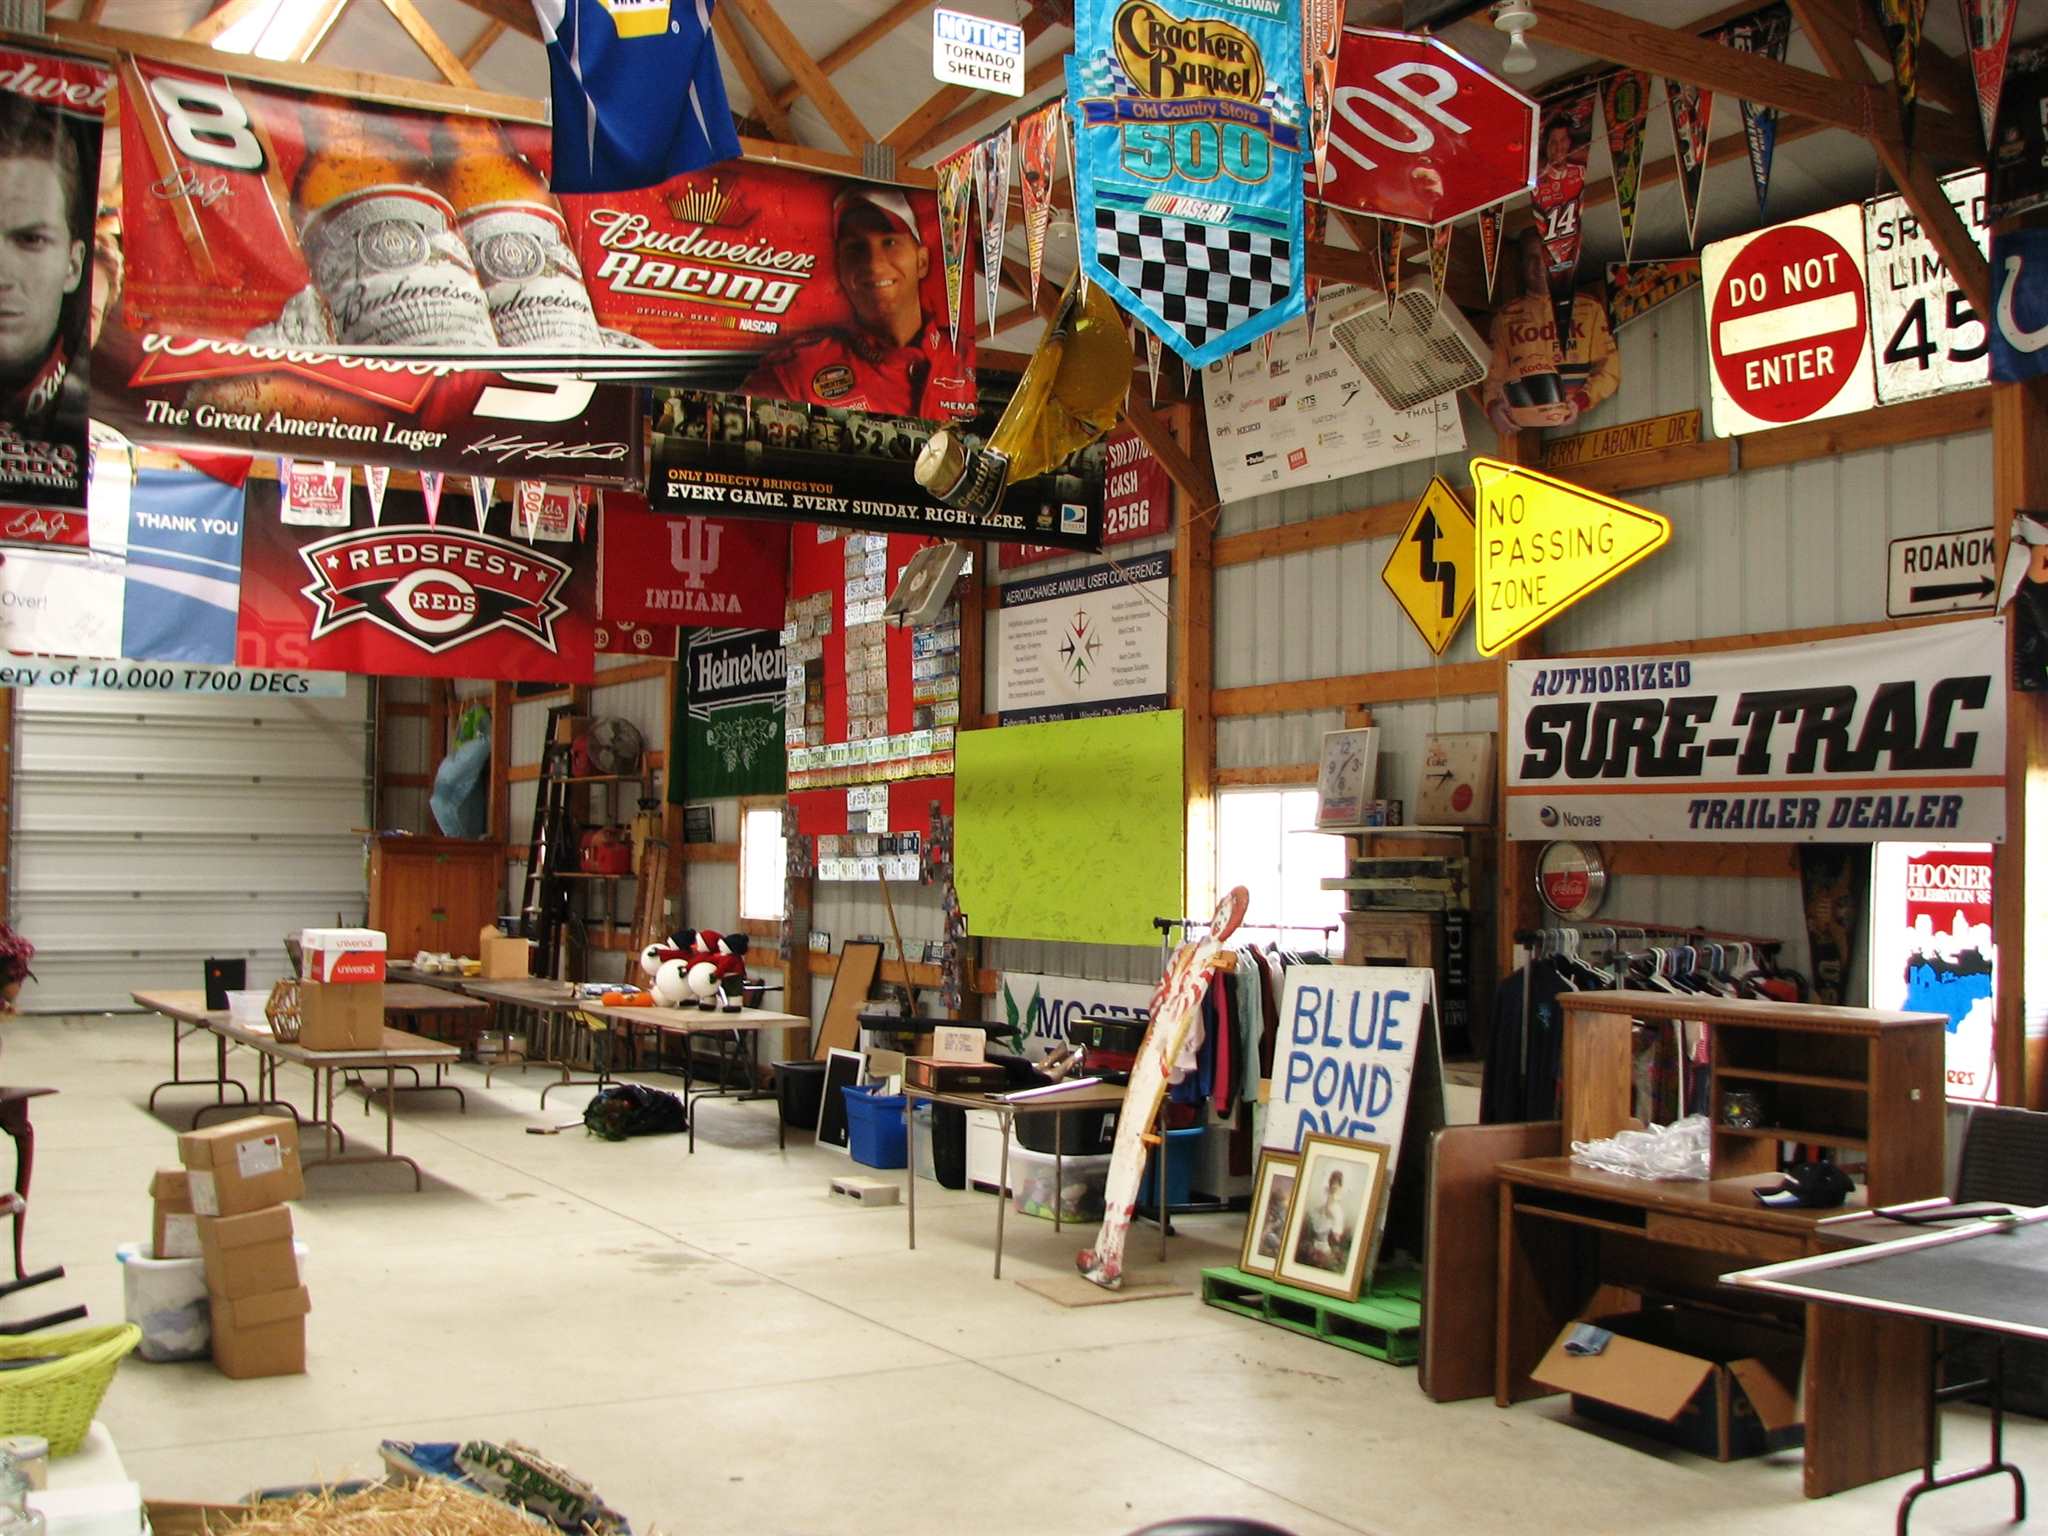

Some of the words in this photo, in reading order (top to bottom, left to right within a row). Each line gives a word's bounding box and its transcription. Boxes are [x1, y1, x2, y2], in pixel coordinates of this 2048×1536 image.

[939, 14, 1020, 53] NOTICE
[1118, 4, 1247, 65] Cracker
[944, 43, 1016, 69] TORNADO
[948, 60, 1012, 84] SHELTER
[1149, 48, 1250, 98] Barrel
[151, 75, 266, 170] 8
[1132, 103, 1158, 118] Old
[1160, 101, 1217, 120] Country
[1219, 101, 1260, 123] Store
[1303, 62, 1472, 184] OP
[1121, 121, 1272, 184] 500
[1173, 197, 1233, 223] NASCAR
[1543, 202, 1577, 243] 14
[1877, 196, 1990, 251] SPD
[590, 208, 816, 270] Budweiser
[1728, 270, 1768, 309] DO
[1782, 253, 1840, 293] NOT
[1889, 254, 1950, 291] LIM
[335, 274, 485, 333] Budweiser
[488, 286, 591, 315] udweiser
[636, 306, 685, 320] OFFICIAL
[739, 317, 778, 335] NASCAR
[1507, 320, 1586, 347] Kodk
[1883, 289, 1990, 371] 45
[1745, 346, 1836, 393] ENTER
[145, 399, 190, 427] The
[196, 403, 262, 433] Great
[265, 415, 379, 443] American
[382, 421, 448, 452] Lager
[1405, 401, 1449, 419] THALES
[1544, 438, 1585, 468] TERRY
[1593, 422, 1656, 459] LABONTE
[1667, 416, 1690, 444] DR.
[668, 469, 703, 482] ONLY
[706, 472, 760, 487] DIRECTV
[762, 478, 808, 492] BRINGS
[808, 481, 833, 494] YOU
[1110, 470, 1138, 499] CASH
[667, 482, 726, 501] EVERY
[729, 488, 788, 508] GAME.
[792, 494, 849, 513] EVERY
[852, 499, 919, 520] SUNDAY.
[925, 506, 978, 526] RIGHT
[1489, 494, 1525, 528] NO
[136, 511, 196, 533] THANK
[201, 518, 239, 536] YOU
[349, 543, 530, 582] REDSFEST
[1489, 522, 1614, 570] PASSING
[1904, 537, 1996, 574] ROANOK
[413, 590, 477, 613] REDS
[645, 588, 742, 613] INDIANA
[1057, 577, 1087, 595] ANNUAL
[1087, 573, 1109, 589] USER
[1491, 575, 1548, 612] ZONE
[50, 664, 78, 685] of
[89, 667, 174, 691] 10,000
[184, 670, 242, 691] T700
[250, 673, 310, 694] DECs
[697, 644, 787, 692] Heineken
[1530, 660, 1692, 697] AUTHORIZED
[1519, 675, 1992, 780] SURE-TRAC
[1563, 812, 1601, 827] Novae
[1687, 796, 1821, 830] TRAILER
[1826, 794, 1964, 830] DEALER
[1908, 863, 1992, 889] HOOSIER
[1907, 887, 1974, 903] CELEBRATION
[337, 963, 376, 976] universal
[1292, 985, 1411, 1050] BLUE
[1284, 1051, 1393, 1118] POND
